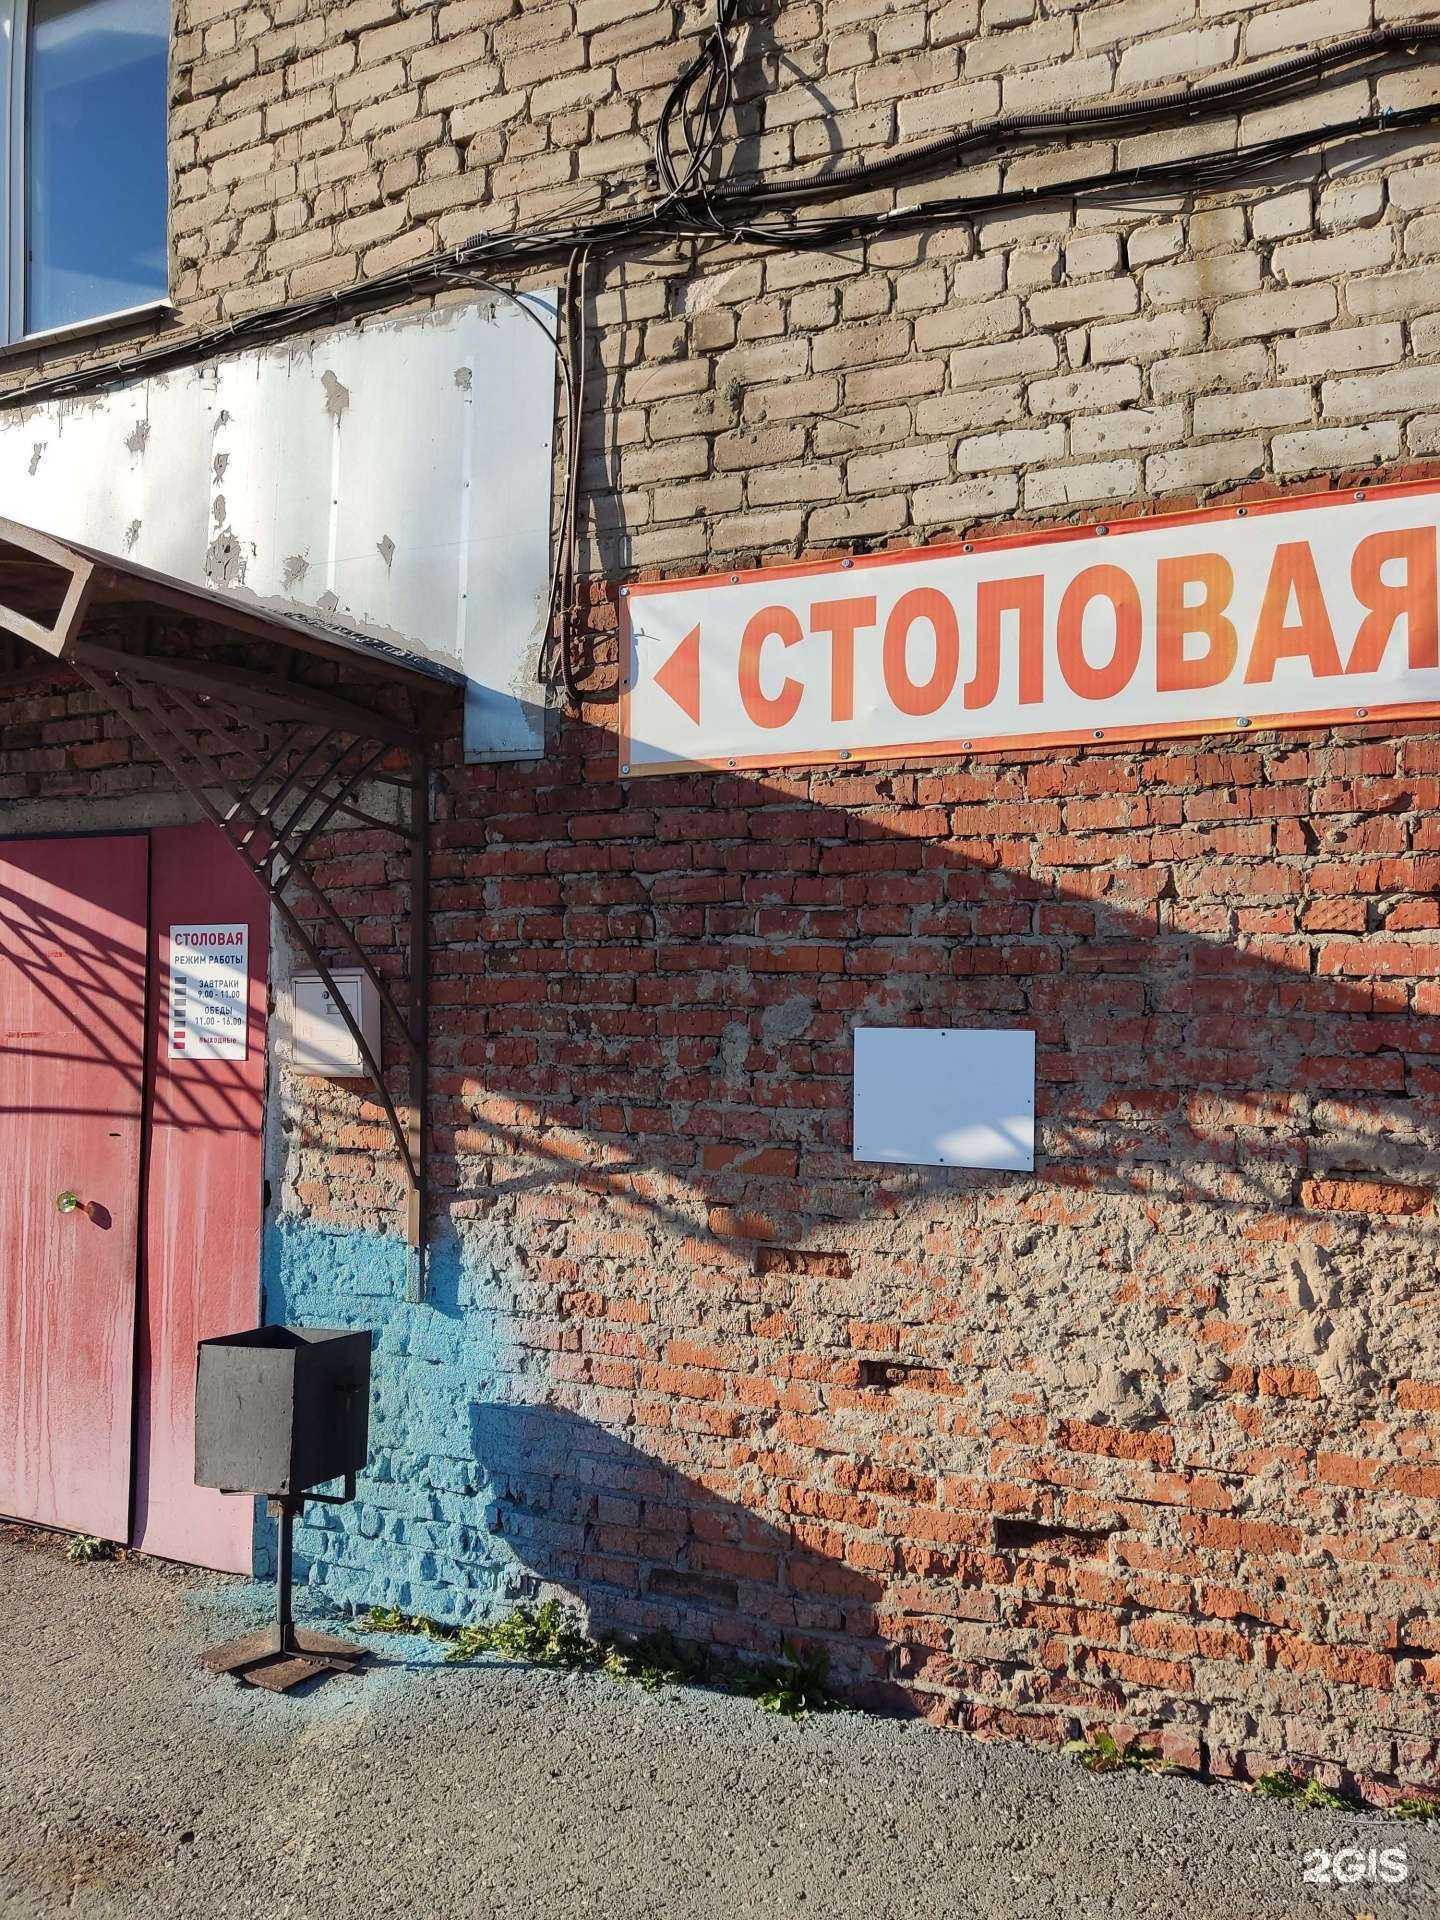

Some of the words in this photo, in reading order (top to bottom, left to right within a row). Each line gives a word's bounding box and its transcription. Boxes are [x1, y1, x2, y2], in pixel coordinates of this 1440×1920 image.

[737, 525, 1439, 730] СТОЛОВАЯ
[174, 932, 244, 946] СТОЛОВАЯ
[174, 955, 206, 964] РЕЖИМ
[208, 955, 243, 965] РАБОТЫ
[199, 979, 239, 988] ЗАВТРАКИ
[197, 990, 213, 999] 9.00
[220, 990, 240, 999] 11.00
[204, 1006, 233, 1016] ОБЕДЫ
[195, 1016, 215, 1026] 11.00
[222, 1016, 242, 1026] 16.00
